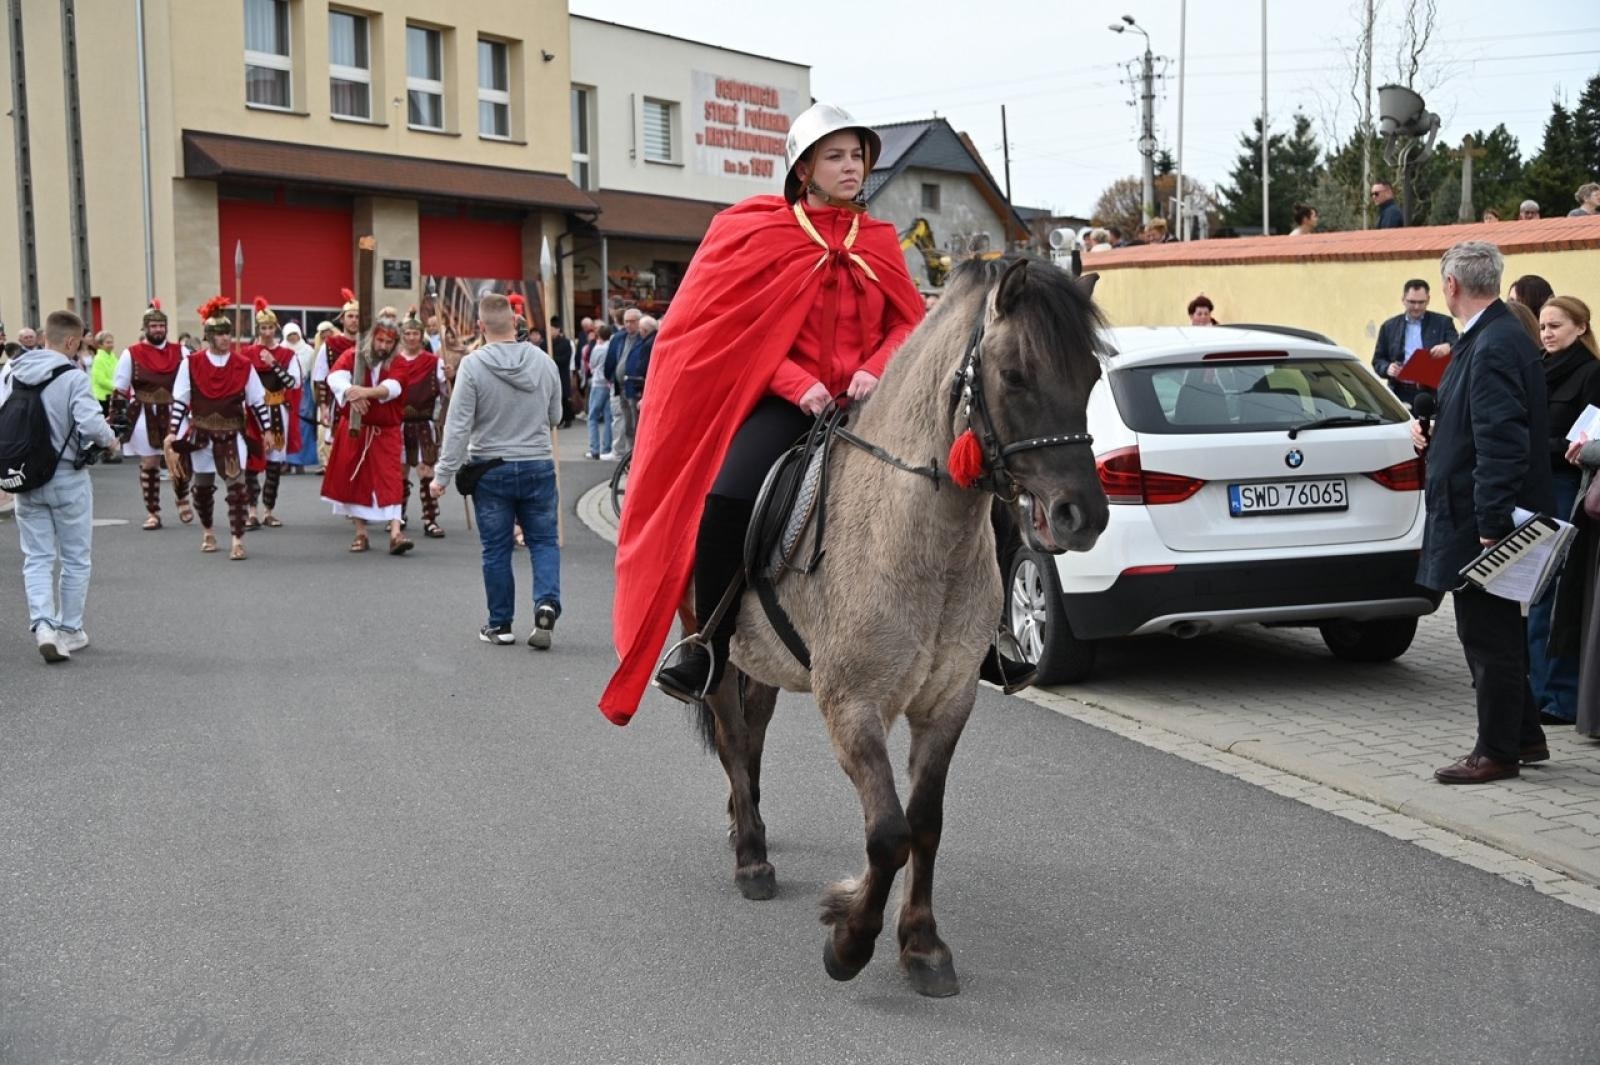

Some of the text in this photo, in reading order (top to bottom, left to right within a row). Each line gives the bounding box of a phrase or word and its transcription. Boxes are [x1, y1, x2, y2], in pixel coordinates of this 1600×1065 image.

[705, 101, 738, 125] STRAŻ
[1242, 486, 1279, 508] SWD
[1285, 483, 1343, 506] 76065
